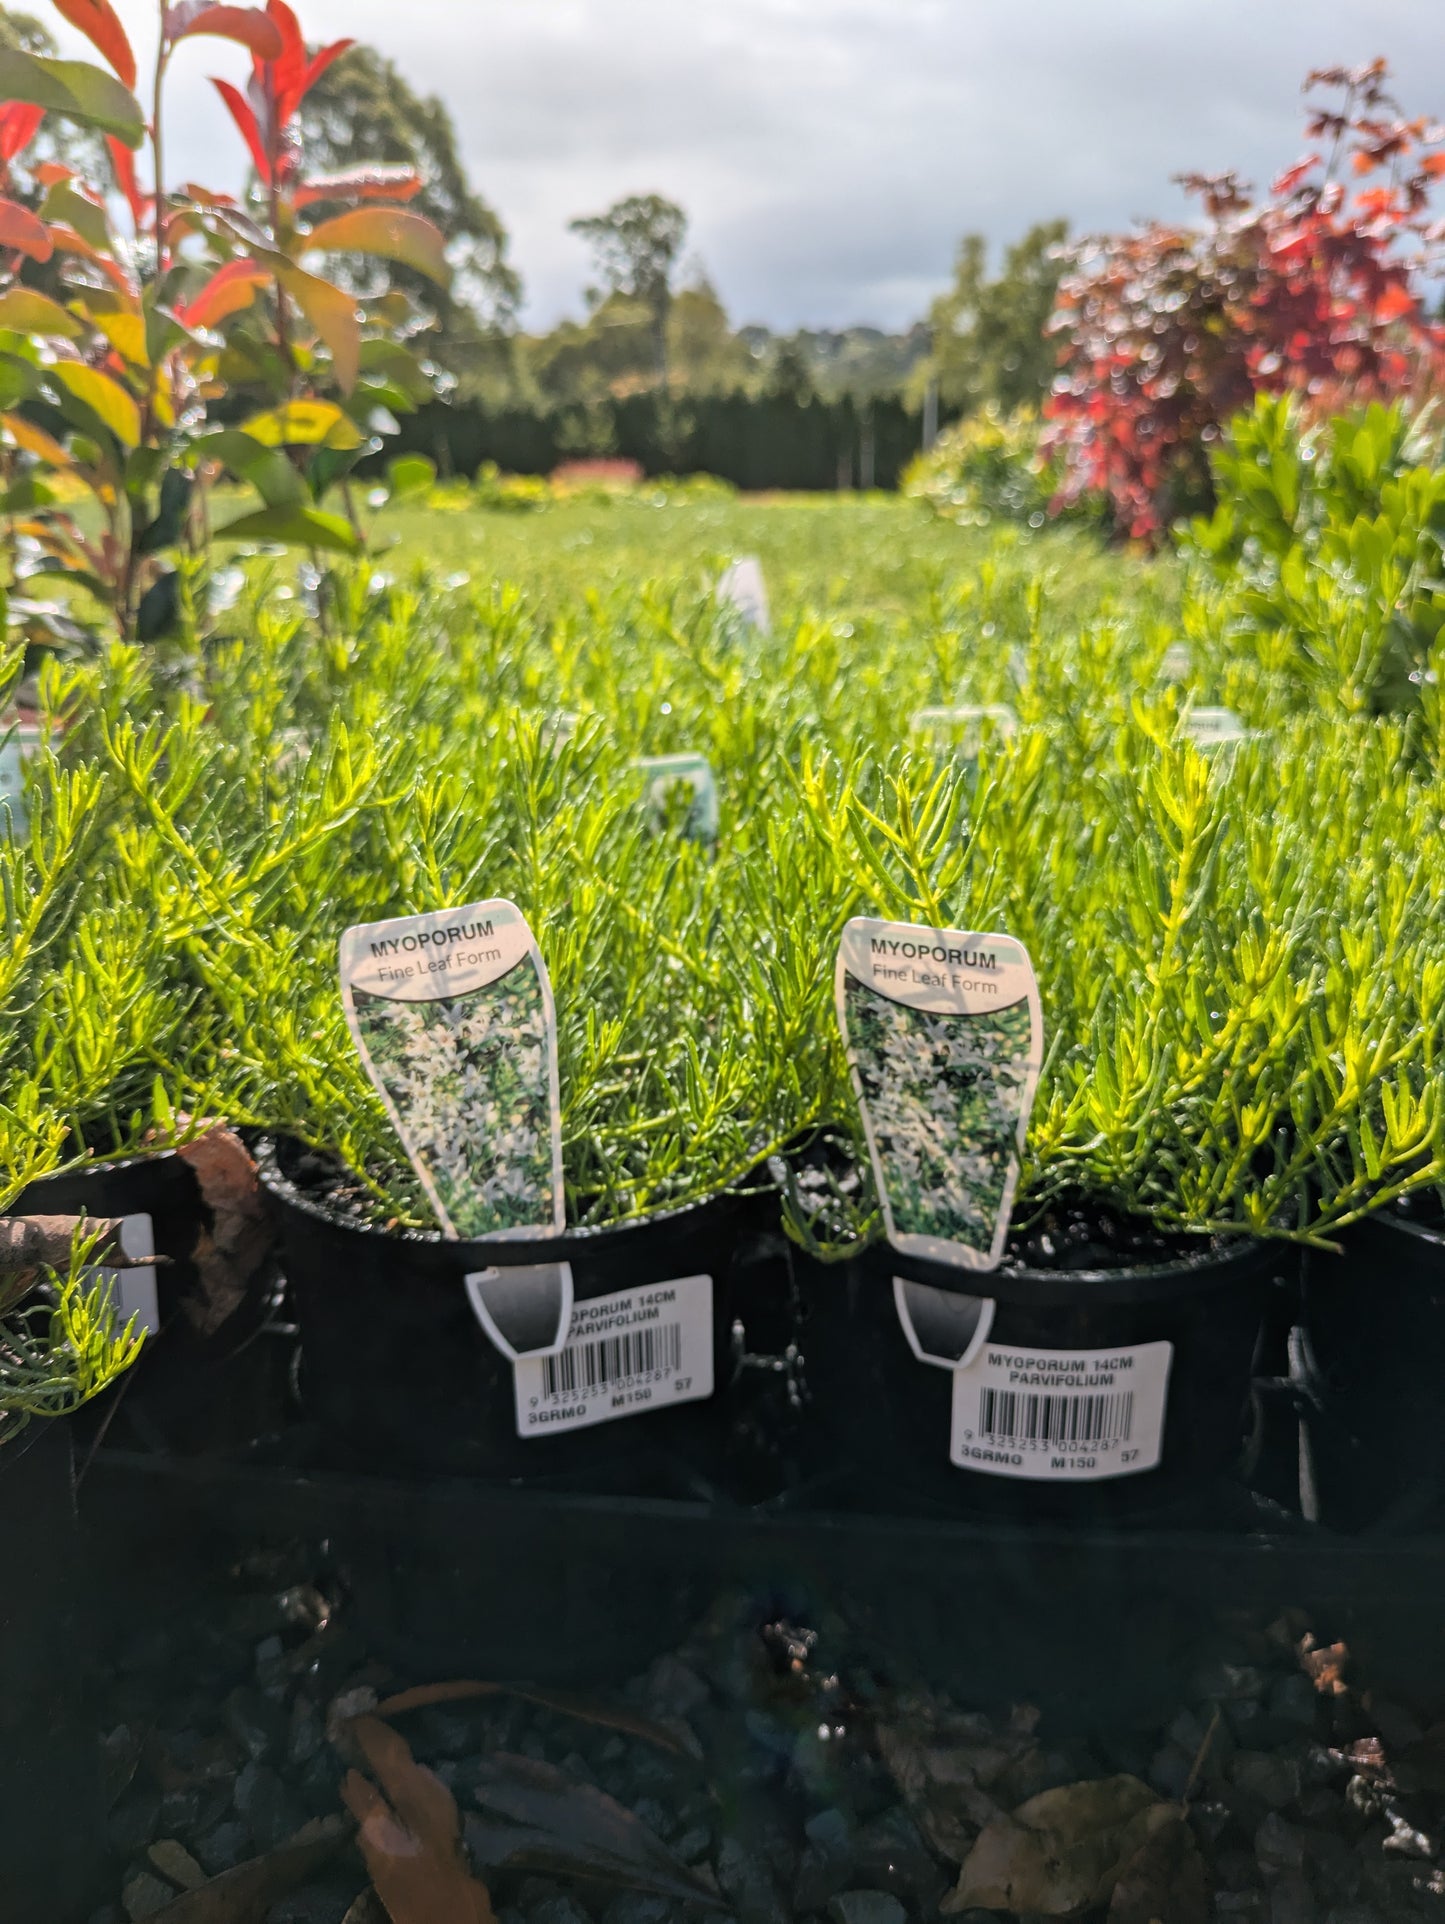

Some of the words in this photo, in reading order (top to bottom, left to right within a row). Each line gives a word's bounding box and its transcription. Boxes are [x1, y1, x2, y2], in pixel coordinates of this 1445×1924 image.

[370, 920, 494, 958] MYOPORUM
[871, 938, 996, 969] MYOPORUM
[378, 965, 414, 982] Fine
[417, 955, 453, 975] Leaf
[457, 949, 501, 967] Form
[873, 964, 907, 981] Fine
[912, 970, 948, 988] Leaf
[952, 975, 997, 994] Form
[571, 1299, 632, 1322] OPORUM
[638, 1289, 676, 1307] 14CM
[567, 1307, 659, 1338] PARVIFOLIUM
[988, 1353, 1085, 1372] MYOPORUM
[1093, 1356, 1134, 1370] 14CM
[611, 1388, 652, 1407] M150
[674, 1376, 693, 1391] 57
[1009, 1371, 1114, 1387] PARVIFOLIUM
[1051, 1456, 1096, 1469] M150
[1121, 1449, 1140, 1462] 57
